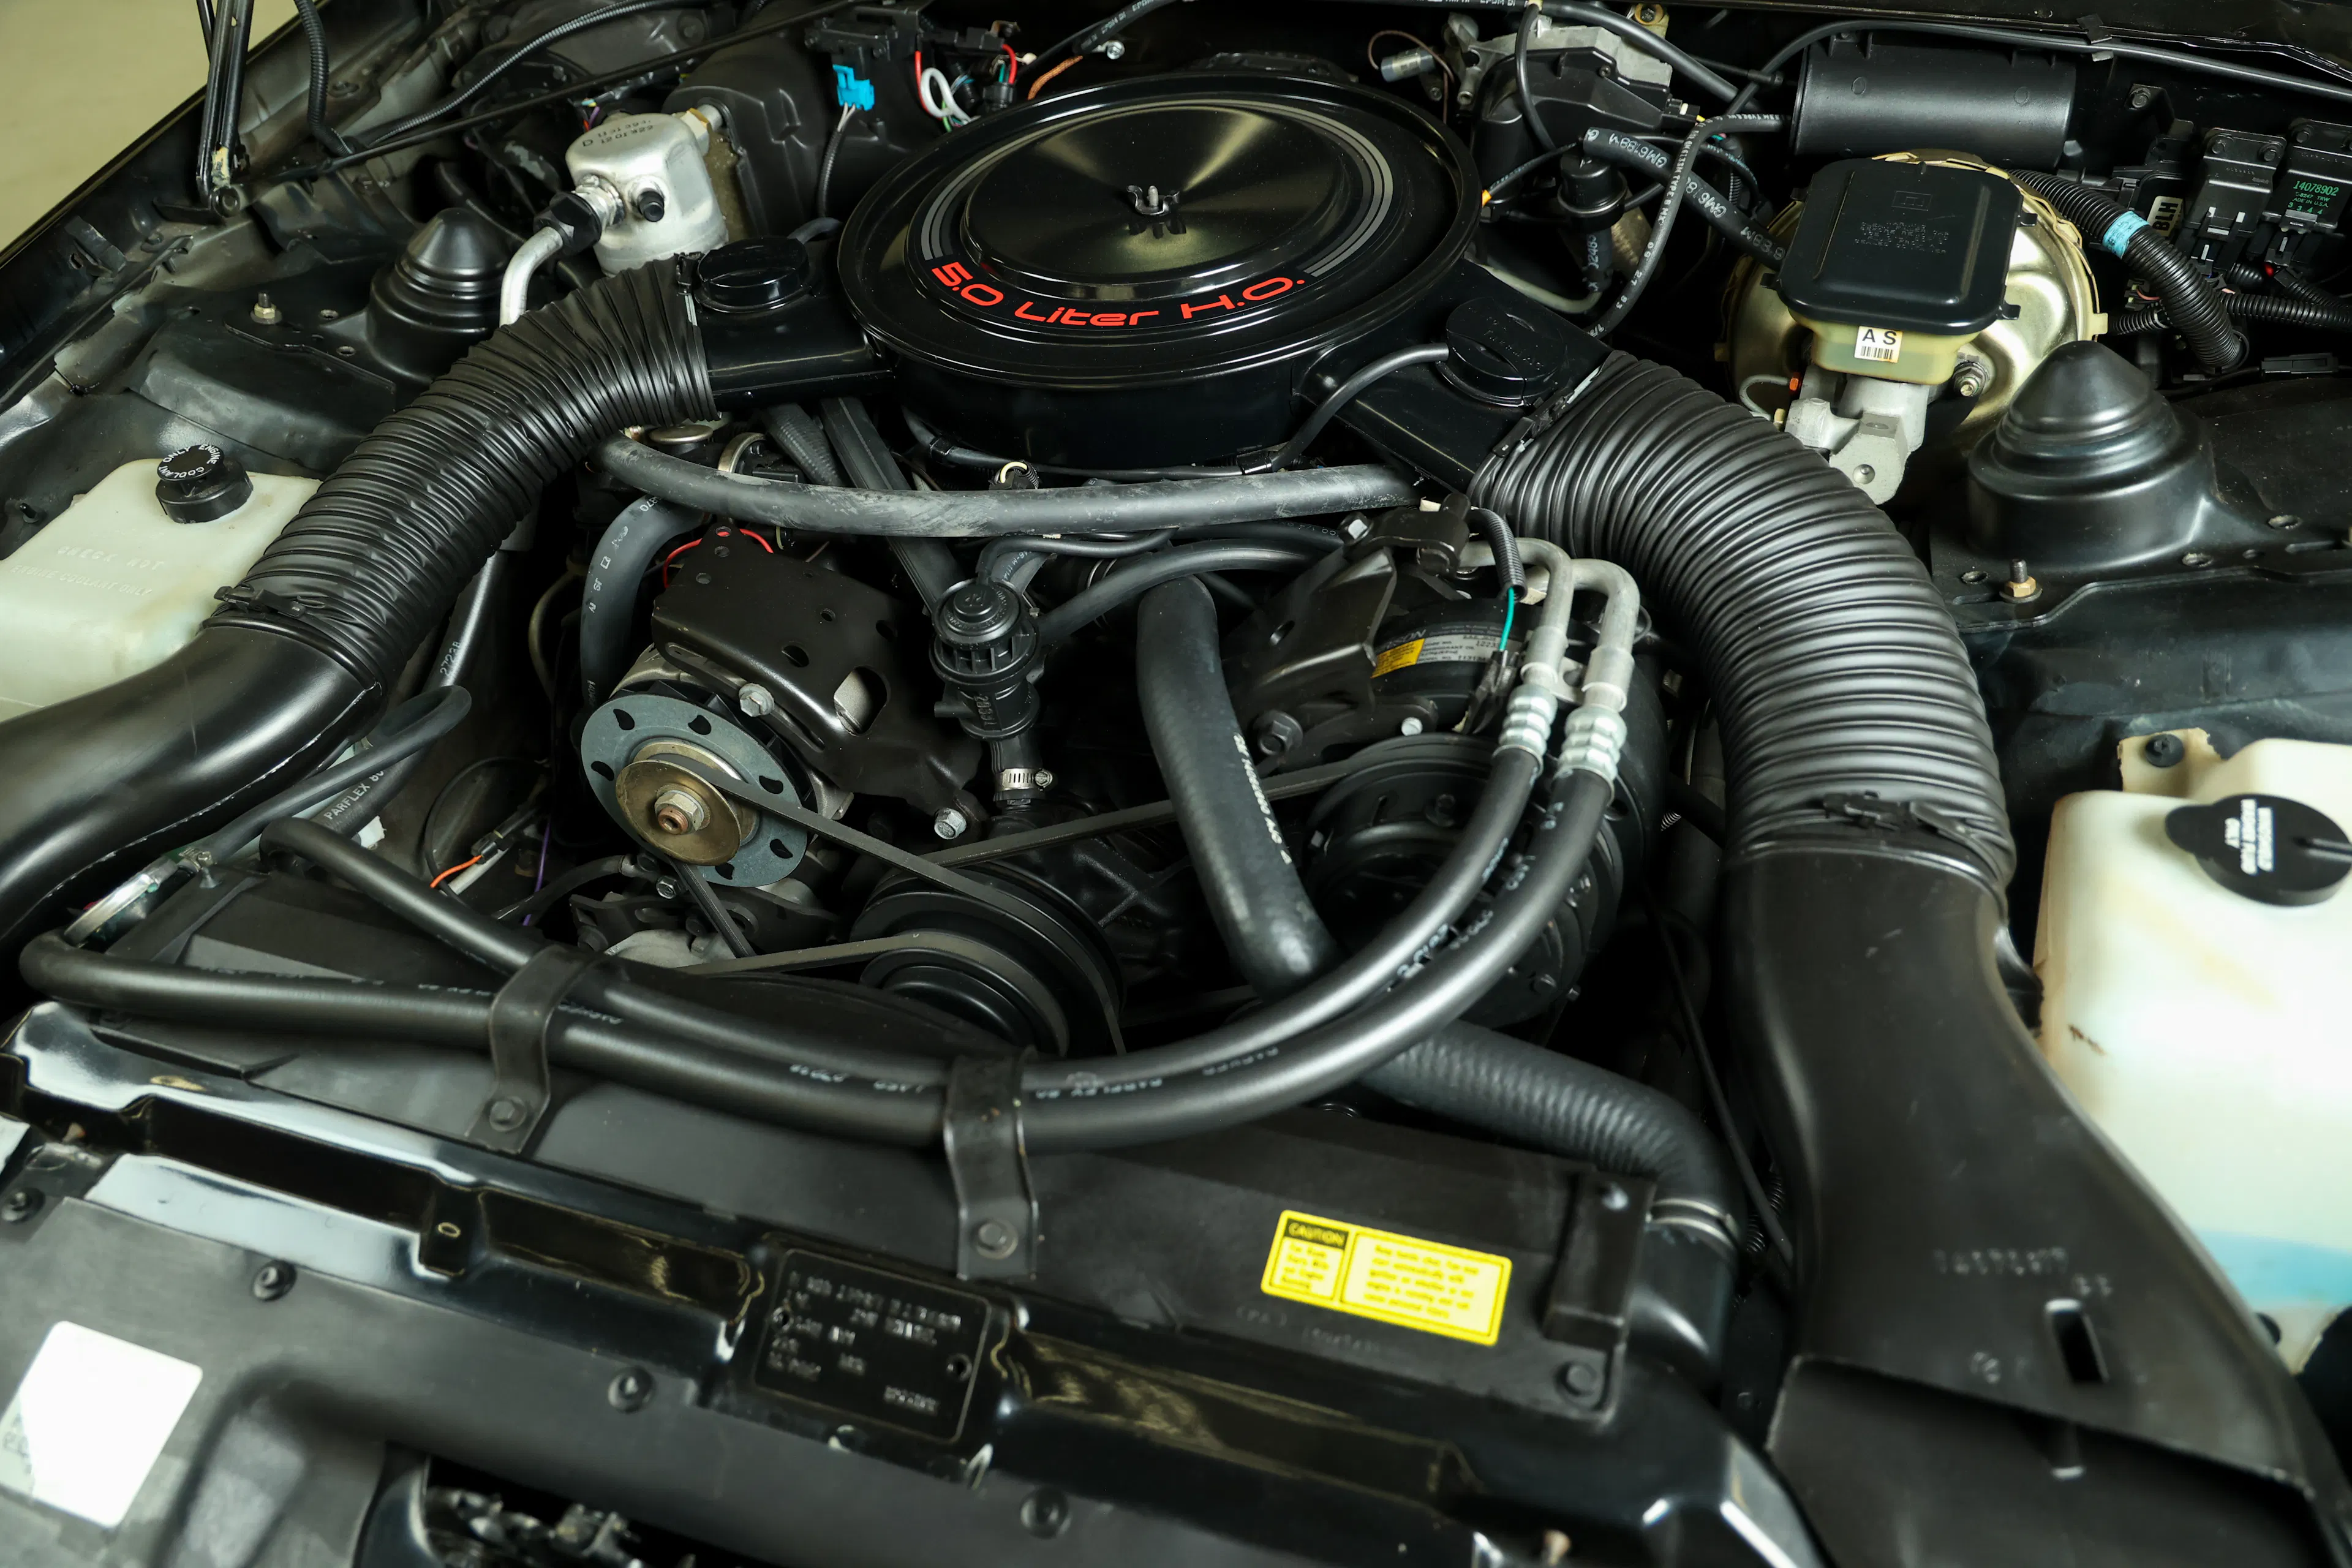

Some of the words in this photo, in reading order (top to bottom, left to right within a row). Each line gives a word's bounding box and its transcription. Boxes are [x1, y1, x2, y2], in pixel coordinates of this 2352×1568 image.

[1667, 175, 1679, 197] TYPE
[2293, 180, 2340, 197] 14078902
[2152, 202, 2179, 231] BLH
[930, 262, 1005, 307] 5.0
[1014, 300, 1159, 327] Liter
[1180, 276, 1306, 320] H.O.
[162, 446, 192, 463] ONLY
[198, 443, 221, 465] ENGINE
[157, 466, 205, 479] COOLANT
[59, 573, 118, 590] COOLANT
[323, 782, 372, 821] PARFLEX
